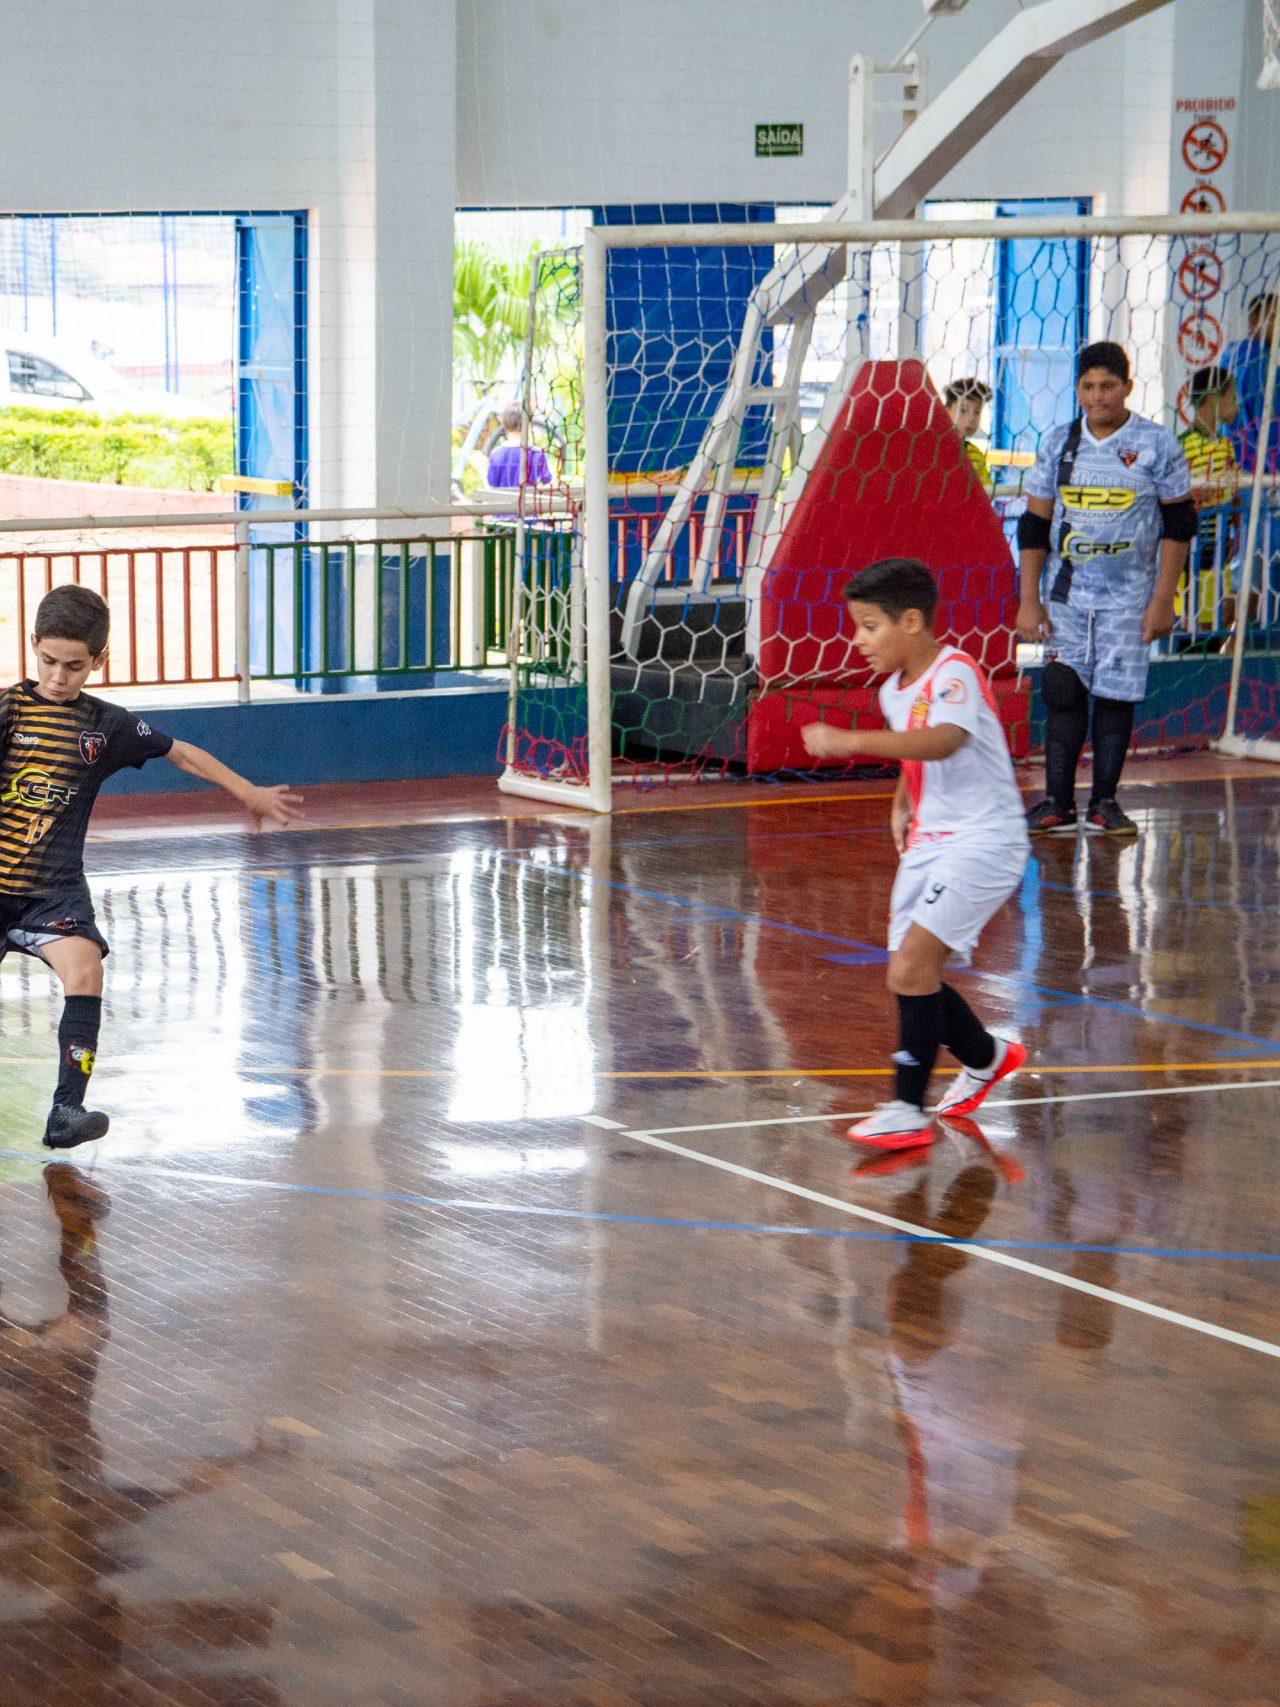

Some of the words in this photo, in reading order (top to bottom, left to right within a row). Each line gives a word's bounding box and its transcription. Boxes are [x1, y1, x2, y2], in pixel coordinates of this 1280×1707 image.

[1176, 98, 1236, 112] PROIBIDO
[758, 127, 801, 145] SAÍDA
[924, 882, 946, 905] 9
